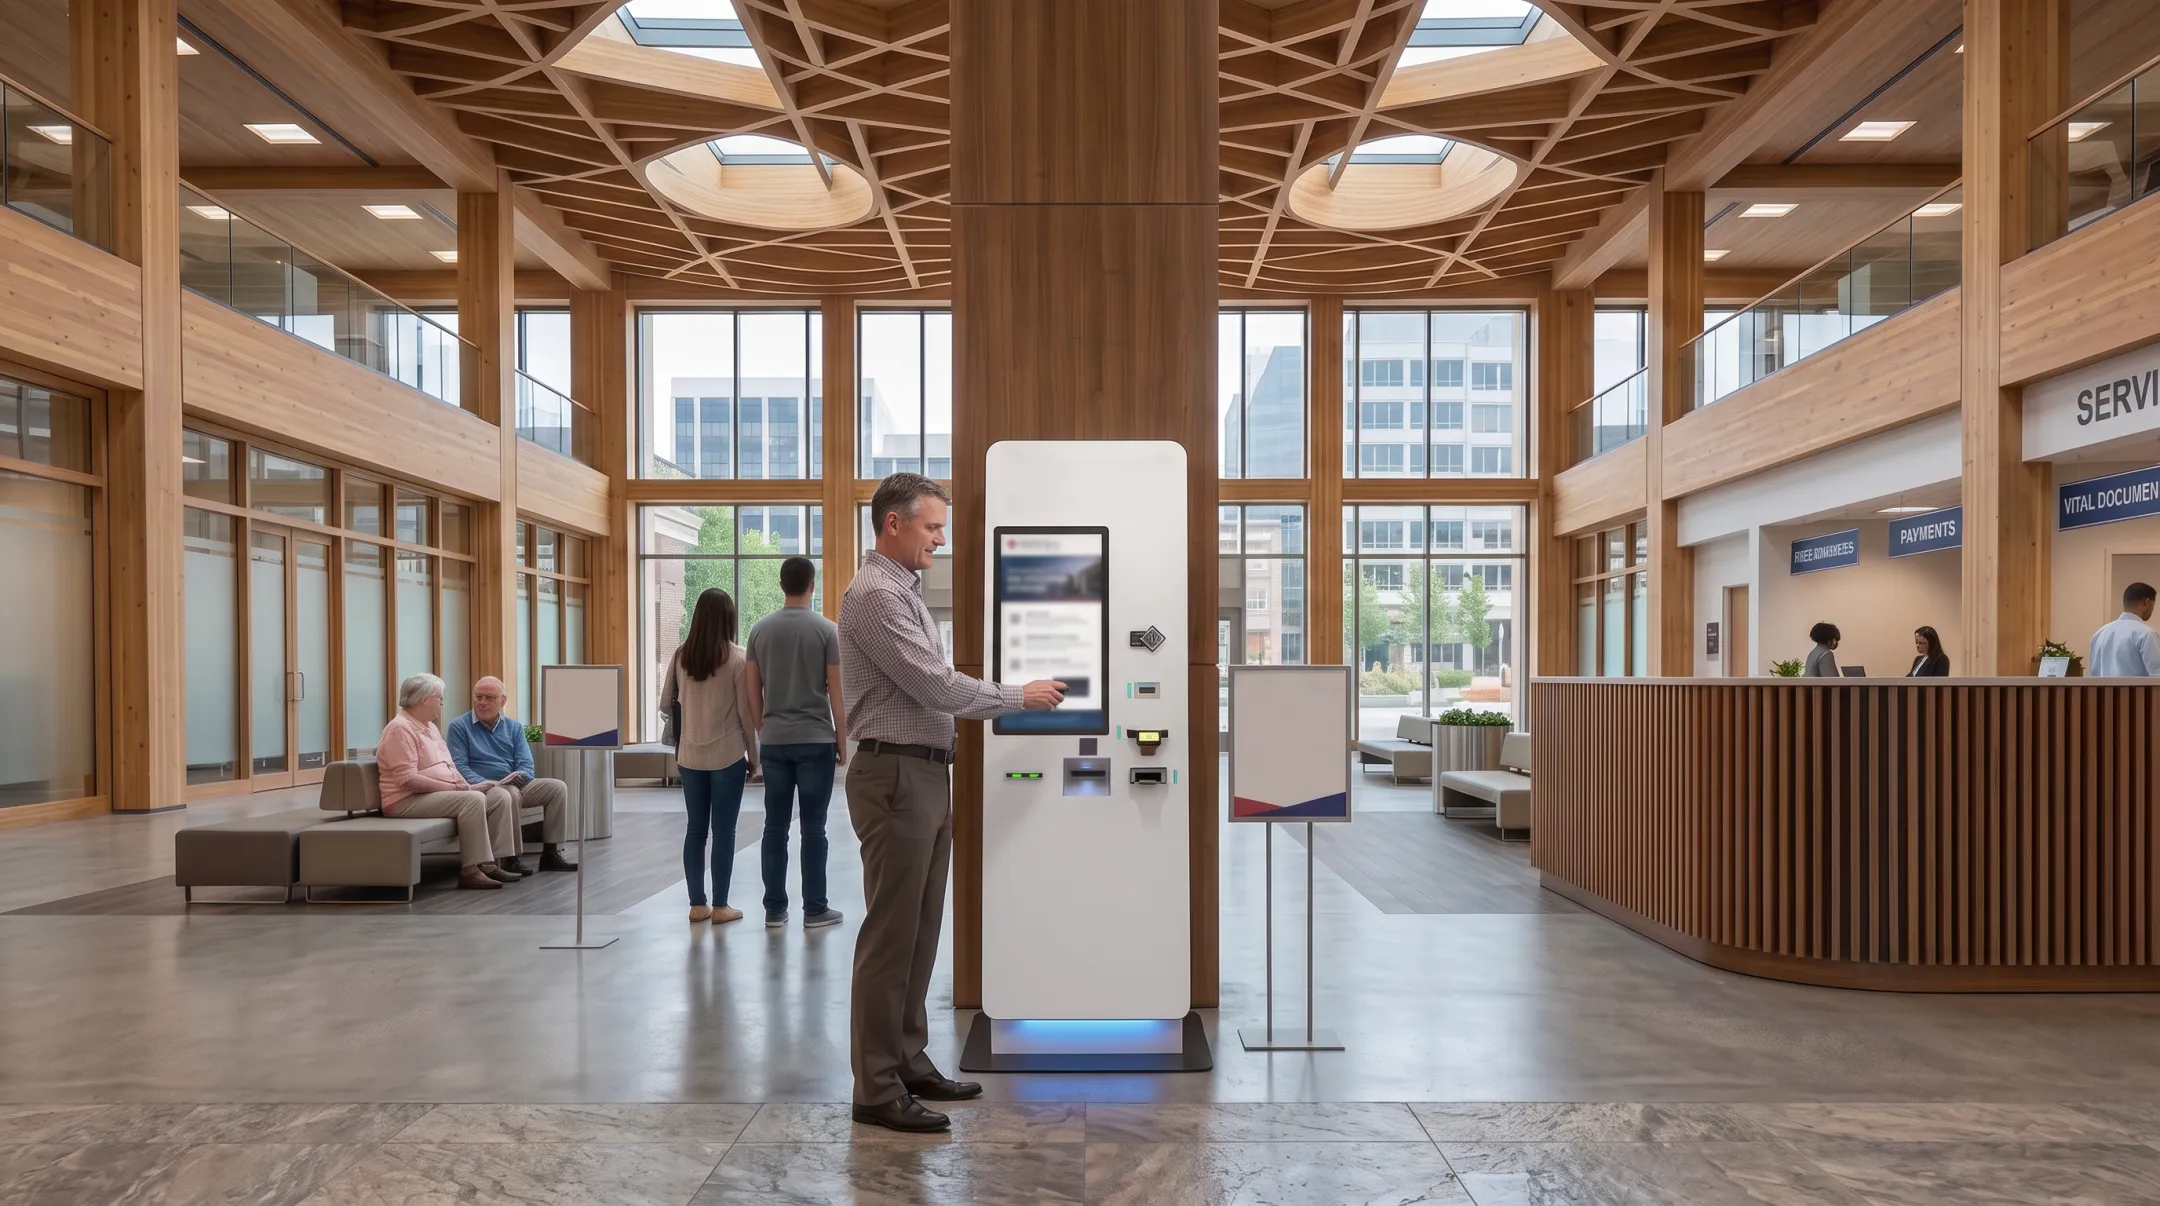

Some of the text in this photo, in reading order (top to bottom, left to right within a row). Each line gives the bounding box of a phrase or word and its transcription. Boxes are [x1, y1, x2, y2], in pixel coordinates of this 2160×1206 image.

[2077, 369, 2158, 426] SERVI
[2064, 481, 2159, 515] VITAL DOCUMEN
[1901, 520, 1956, 544] PAYMENTS
